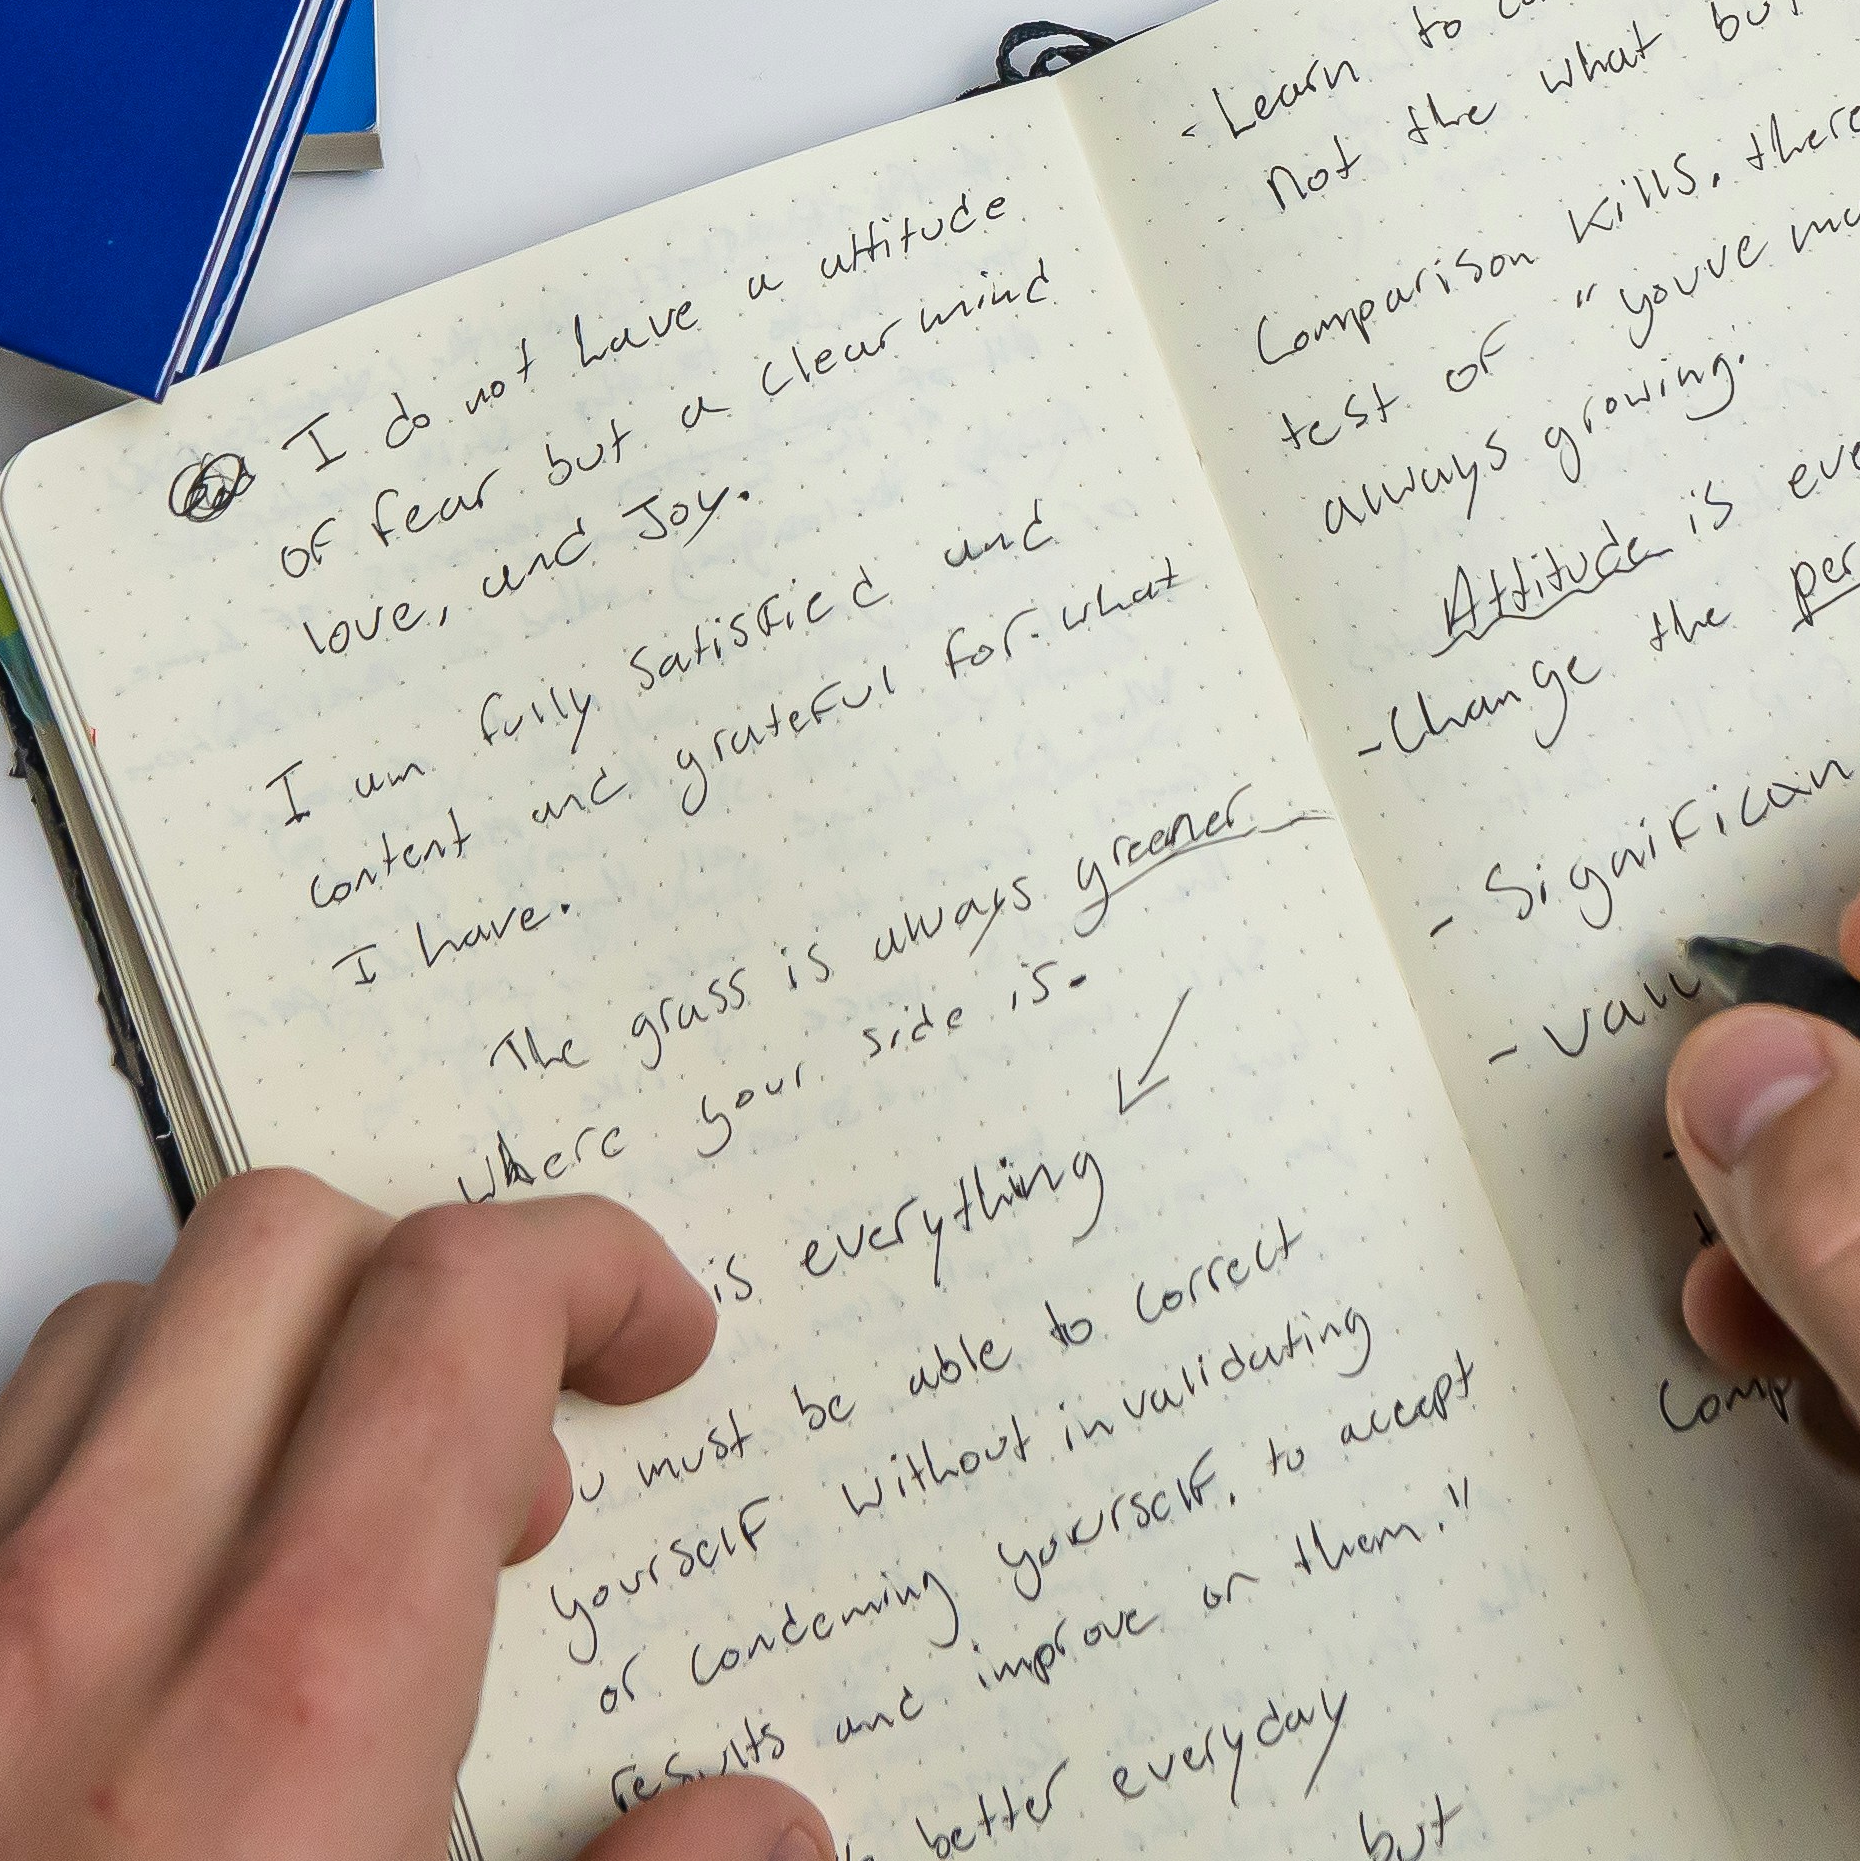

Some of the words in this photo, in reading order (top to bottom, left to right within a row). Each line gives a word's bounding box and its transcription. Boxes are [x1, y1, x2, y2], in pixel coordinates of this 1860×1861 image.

[1406, 93, 1499, 144] the
[1539, 27, 1667, 96] what
[1416, 4, 1462, 49] to
[281, 413, 345, 471] I
[385, 391, 430, 451] do
[467, 347, 536, 415] not
[573, 298, 699, 363] have
[376, 471, 503, 546] fear
[549, 428, 629, 487] but
[760, 319, 904, 397] clear
[920, 258, 1051, 334] mind
[1279, 386, 1402, 449] test
[1447, 320, 1514, 391] of
[1322, 422, 1510, 536] always
[302, 594, 448, 654] love,
[482, 526, 593, 596] and
[1444, 516, 1671, 641] Attitude
[1686, 478, 1736, 533] is
[1650, 602, 1732, 654] the
[265, 760, 314, 825] I
[356, 758, 426, 797] am
[482, 684, 593, 754] fully
[944, 499, 1058, 566] and
[312, 813, 471, 910] content
[531, 770, 631, 827] and
[677, 663, 896, 815] grateful
[333, 942, 378, 987] I
[490, 1023, 589, 1078] The
[630, 966, 749, 1070] grass
[785, 939, 832, 989] is
[875, 874, 1032, 957] always
[1073, 782, 1257, 937] greener
[698, 1065, 807, 1158] your
[864, 1004, 967, 1061] side
[710, 1253, 754, 1303] is
[800, 1146, 1106, 1288] everything
[641, 1417, 755, 1485] must
[796, 1386, 858, 1432] be
[907, 1339, 1015, 1398] able
[1051, 1301, 1094, 1346] to
[1135, 1215, 1303, 1324] correct
[551, 1494, 772, 1664] yourself
[841, 1417, 1034, 1517] without
[598, 1653, 644, 1716] or
[1266, 1435, 1305, 1477] to
[1339, 1356, 1477, 1447] accept
[834, 1687, 927, 1741] and
[976, 1610, 1159, 1692] improve
[916, 1760, 1071, 1857] better
[1359, 1795, 1470, 1861] but
